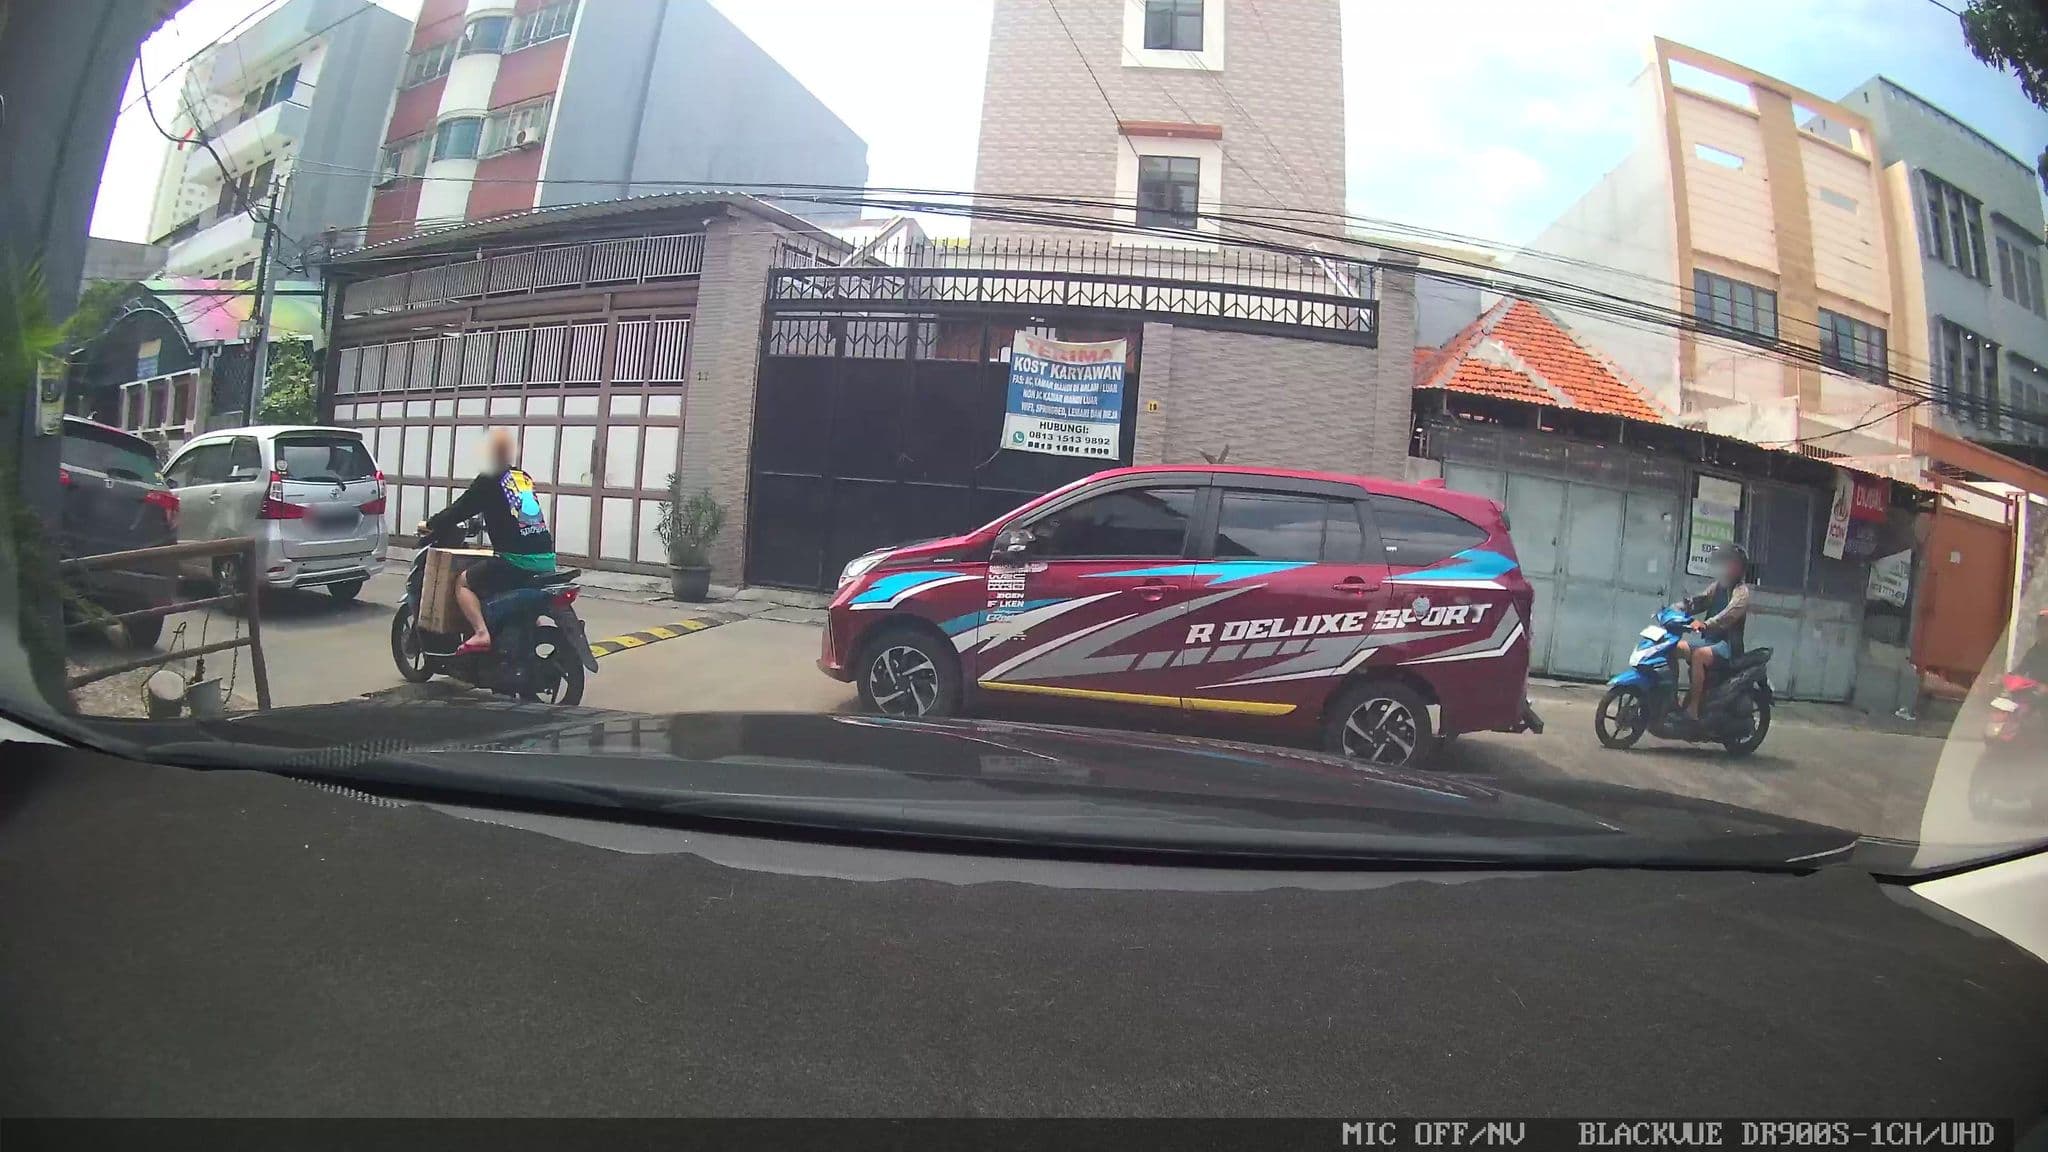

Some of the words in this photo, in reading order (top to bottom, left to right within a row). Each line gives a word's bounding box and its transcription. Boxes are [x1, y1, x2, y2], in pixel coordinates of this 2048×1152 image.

[1025, 338, 1113, 361] TERIMA
[1014, 356, 1048, 374] KOST
[1050, 363, 1121, 380] KARYAWAN
[1040, 421, 1089, 434] HUBUNGI:
[1029, 431, 1053, 440] 0813
[1057, 435, 1081, 443] 1513
[1085, 437, 1110, 445] 9892
[987, 600, 1024, 608] FLKEN
[1220, 611, 1368, 642] DELUXE
[1371, 603, 1493, 630] SPORT
